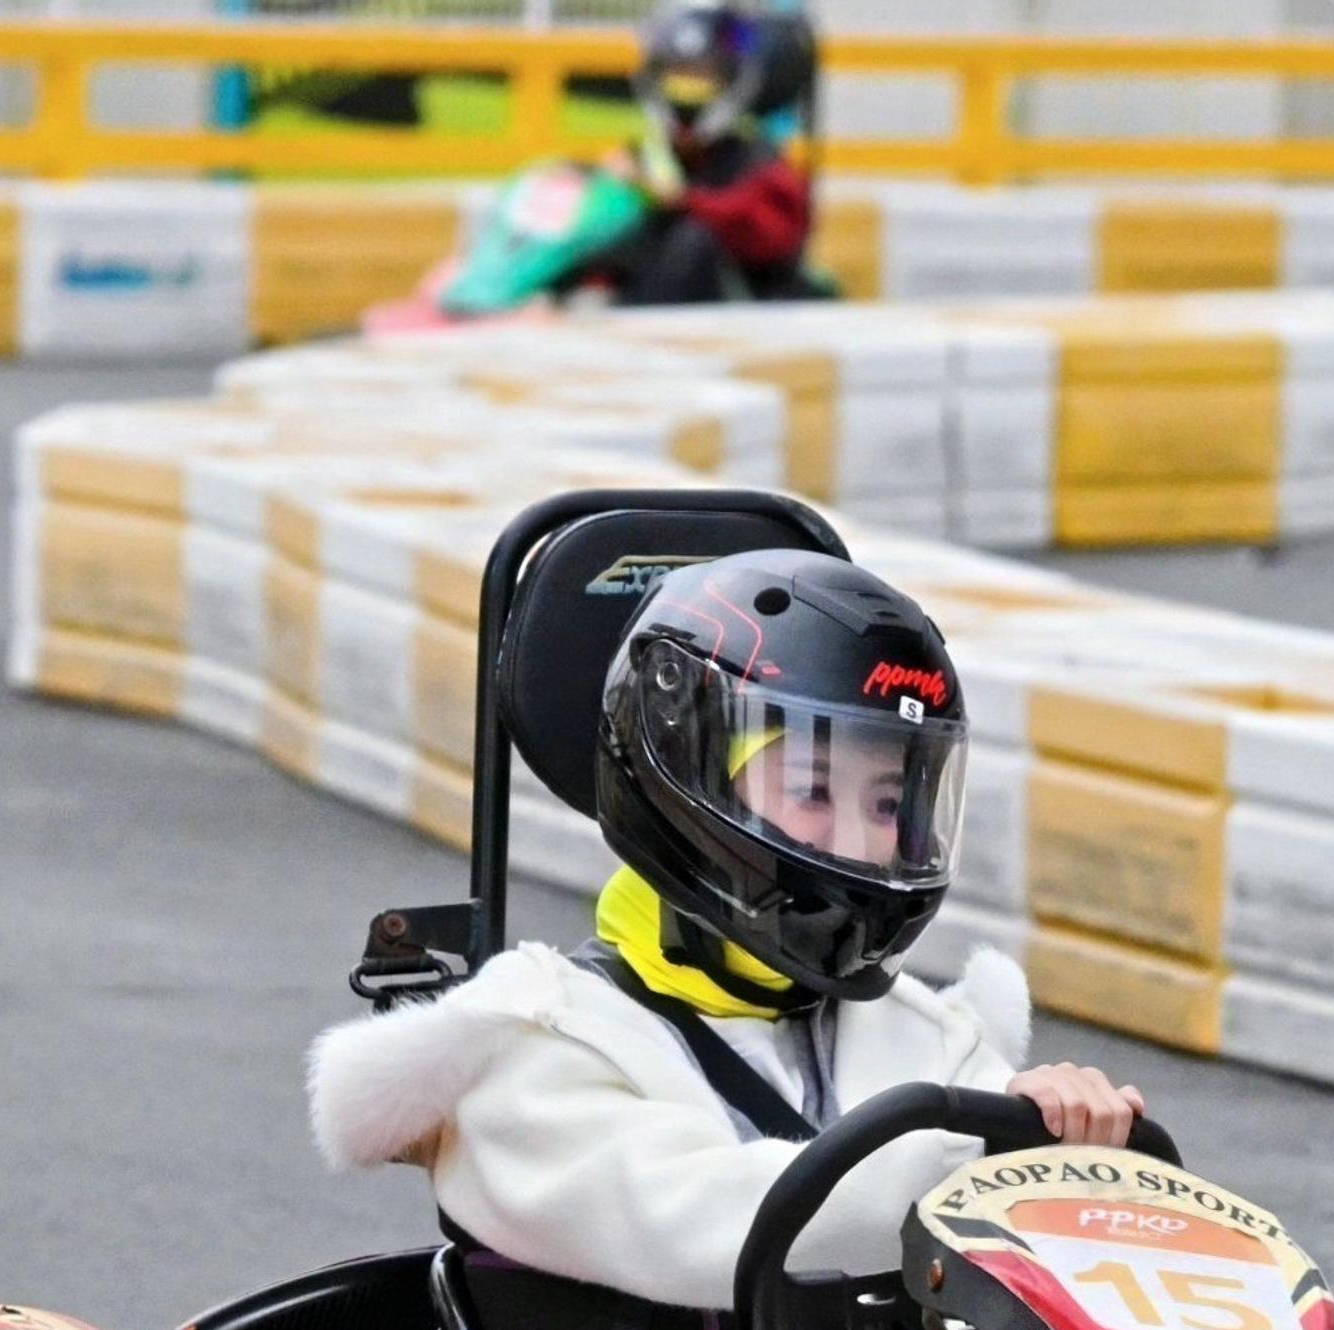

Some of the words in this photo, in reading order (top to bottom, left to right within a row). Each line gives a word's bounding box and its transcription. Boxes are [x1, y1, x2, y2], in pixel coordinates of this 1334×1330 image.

[907, 702, 917, 719] S
[938, 1162, 1121, 1212] PAOPAO
[1136, 1169, 1287, 1241] SPORT
[1078, 1208, 1189, 1236] PPKD
